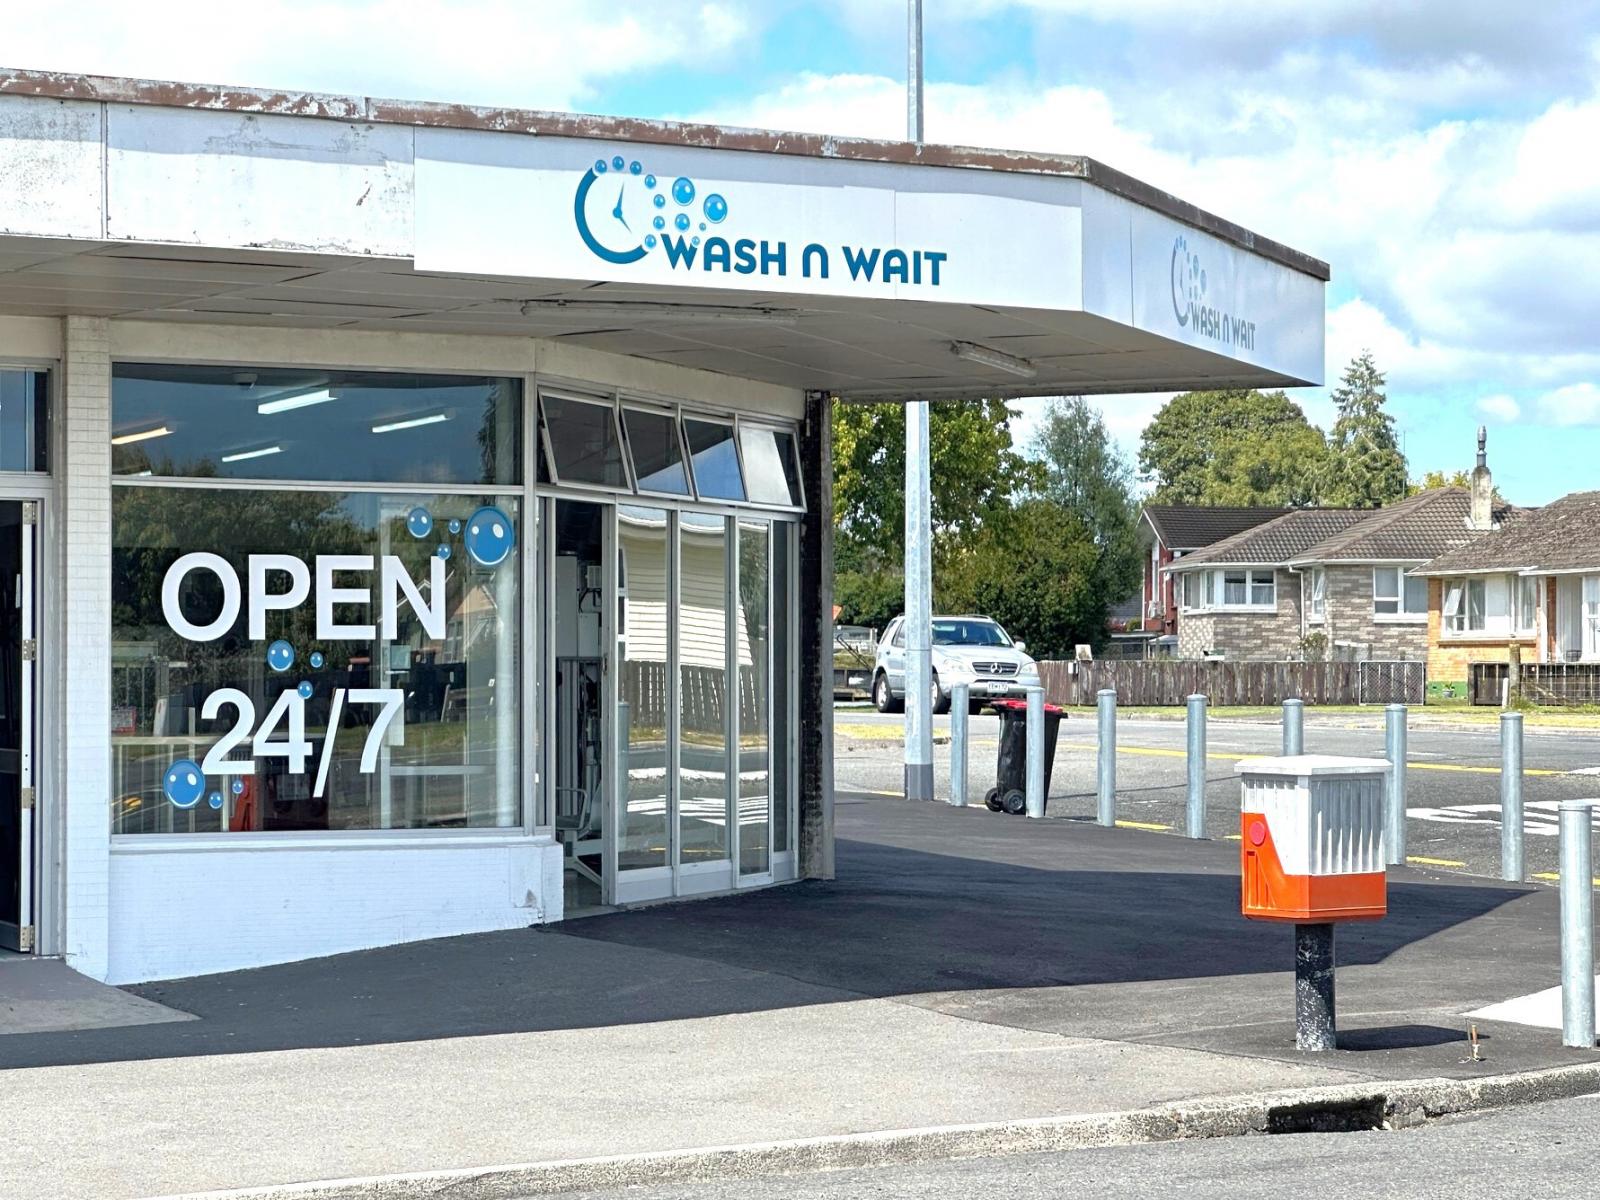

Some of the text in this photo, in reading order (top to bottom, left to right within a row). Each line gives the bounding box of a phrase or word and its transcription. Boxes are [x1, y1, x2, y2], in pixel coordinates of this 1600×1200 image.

[660, 233, 787, 276] WASH
[842, 246, 948, 286] WAIT
[1190, 302, 1221, 341] WASH
[1231, 316, 1256, 351] WAIT
[161, 552, 447, 642] OPEN
[200, 688, 405, 798] 24/7
